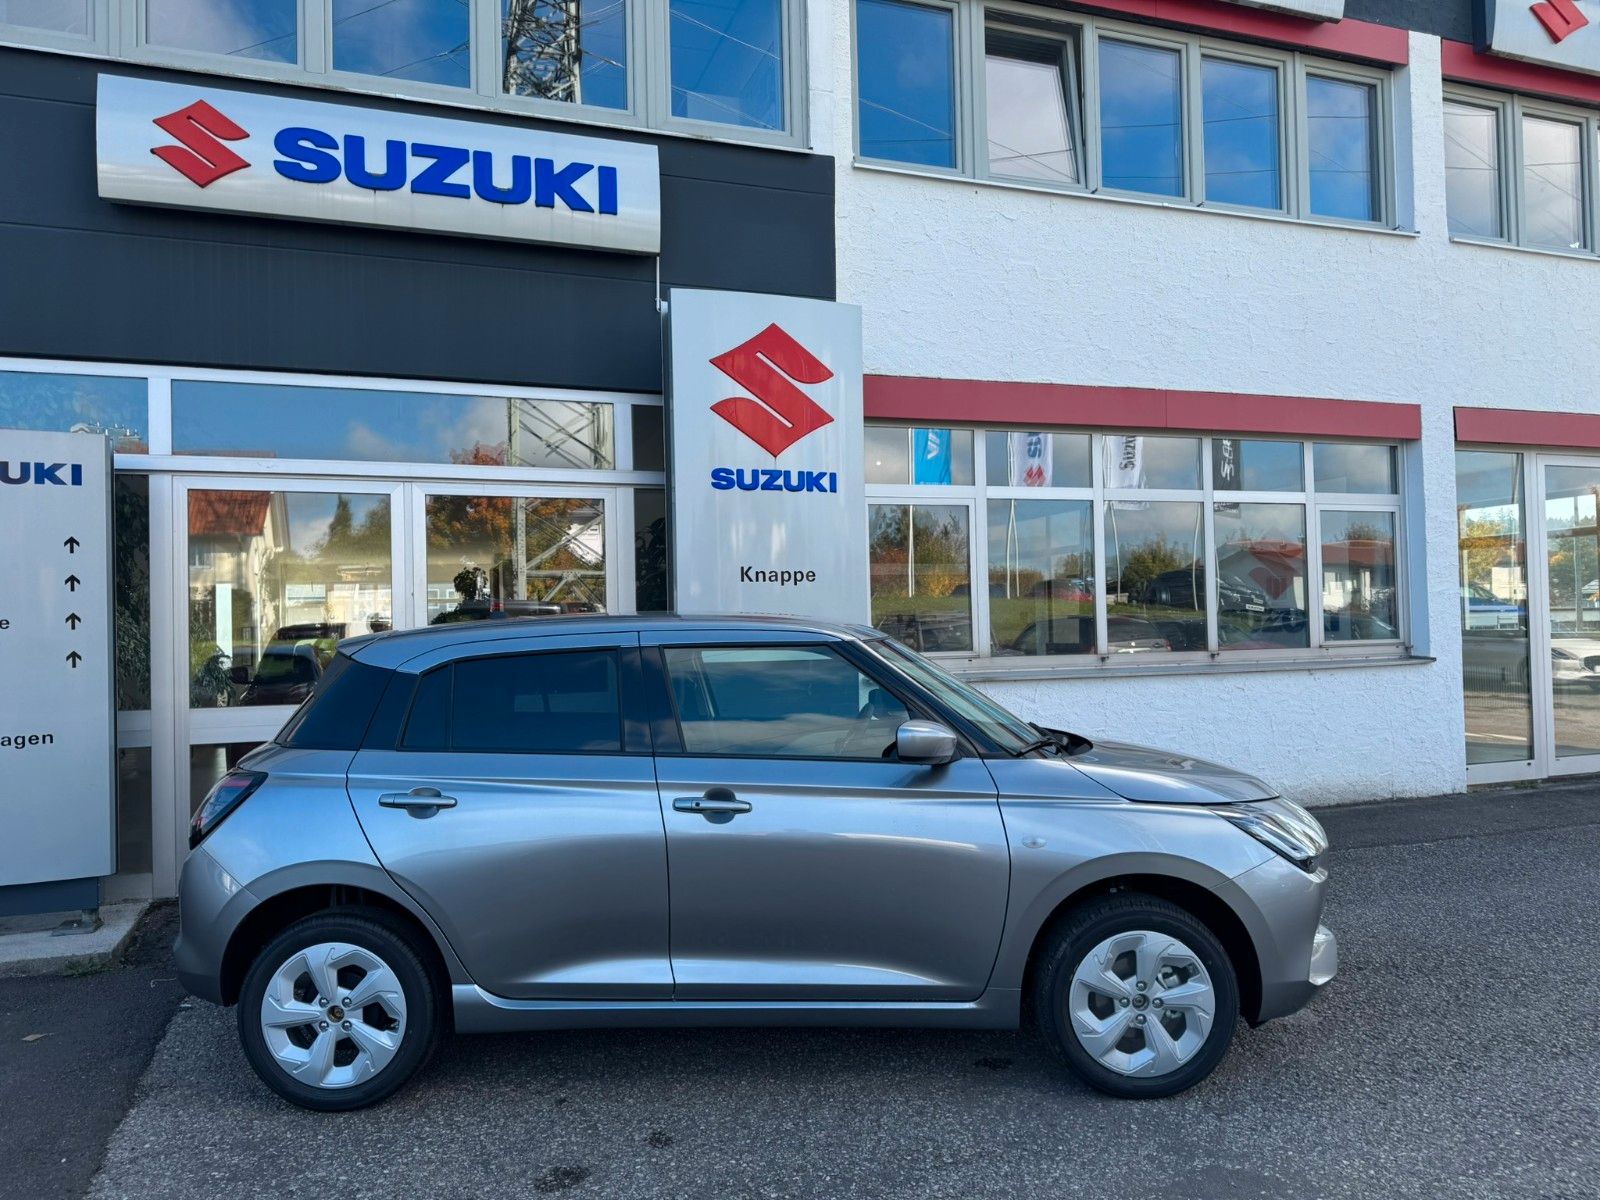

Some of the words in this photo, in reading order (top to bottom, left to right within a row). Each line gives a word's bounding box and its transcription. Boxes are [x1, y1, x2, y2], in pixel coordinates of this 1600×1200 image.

[273, 126, 618, 216] SUZUKI
[0, 461, 82, 486] UKI
[710, 467, 838, 494] SUZUKI
[740, 565, 817, 586] Knappe
[0, 733, 54, 750] agen
